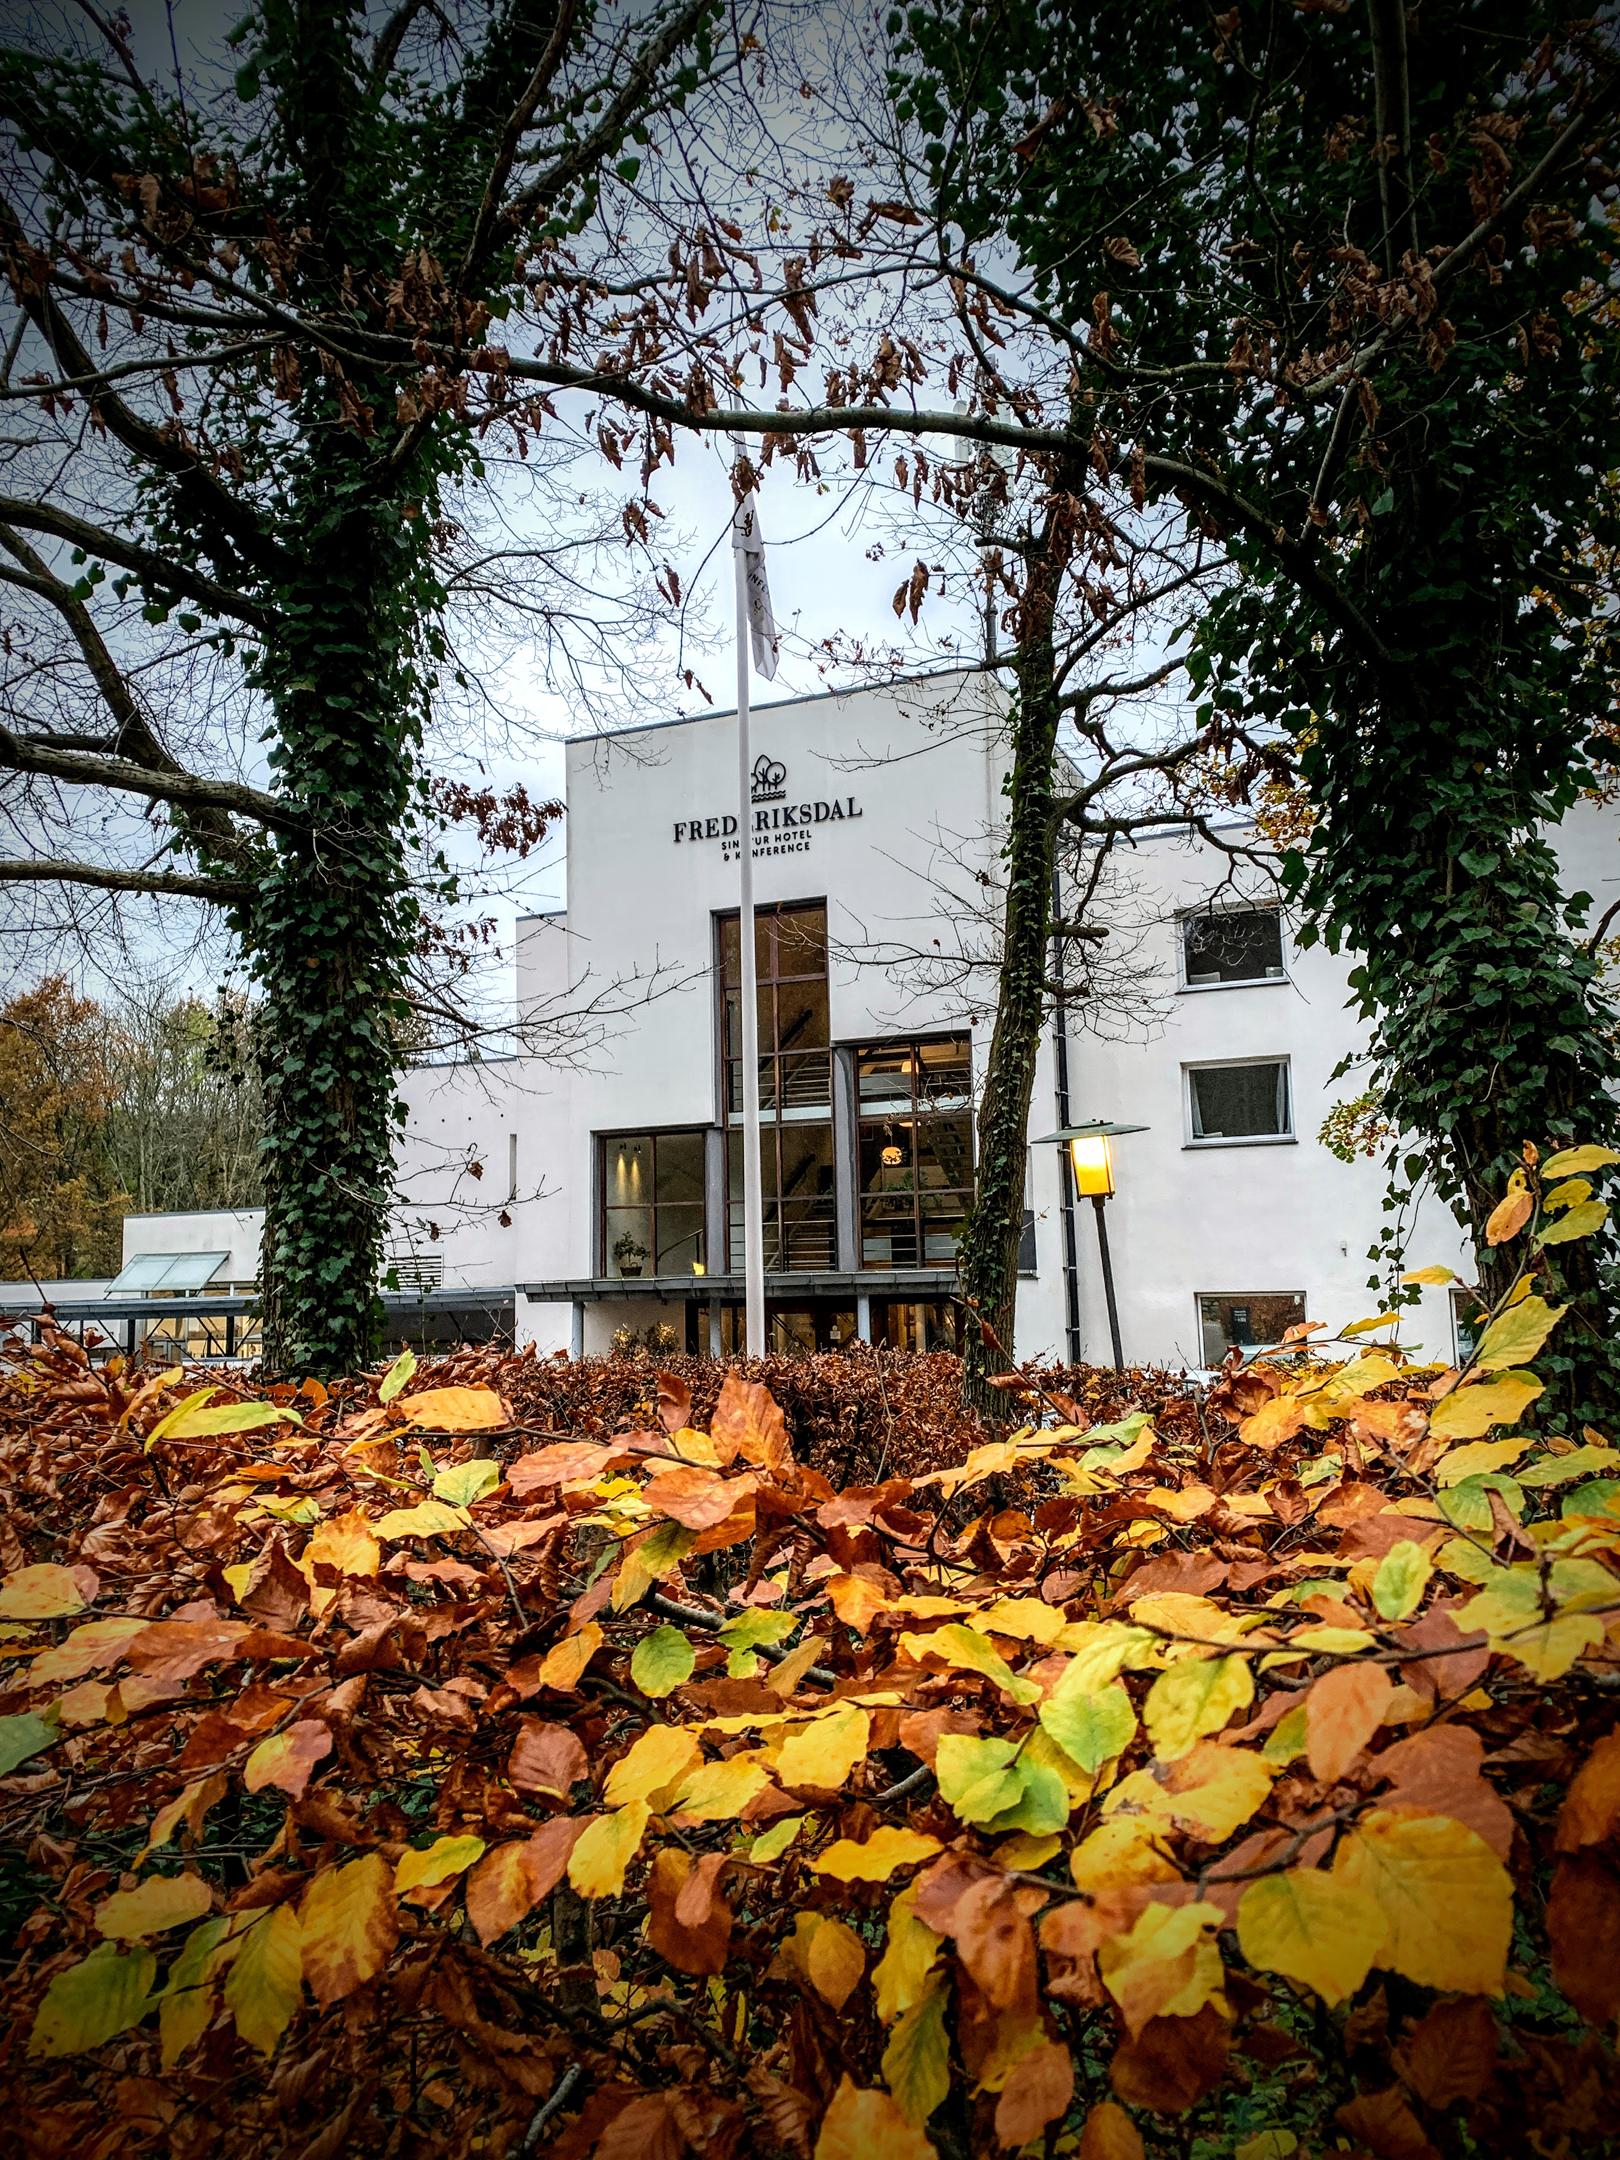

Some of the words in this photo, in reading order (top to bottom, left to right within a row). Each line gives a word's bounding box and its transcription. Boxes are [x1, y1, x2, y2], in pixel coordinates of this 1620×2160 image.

[673, 796, 863, 843] FREDRIKSDAL
[721, 836, 770, 851] SINUR
[774, 830, 812, 842] HOTEL
[723, 852, 730, 862] &
[735, 841, 811, 860] KNFERENCE
